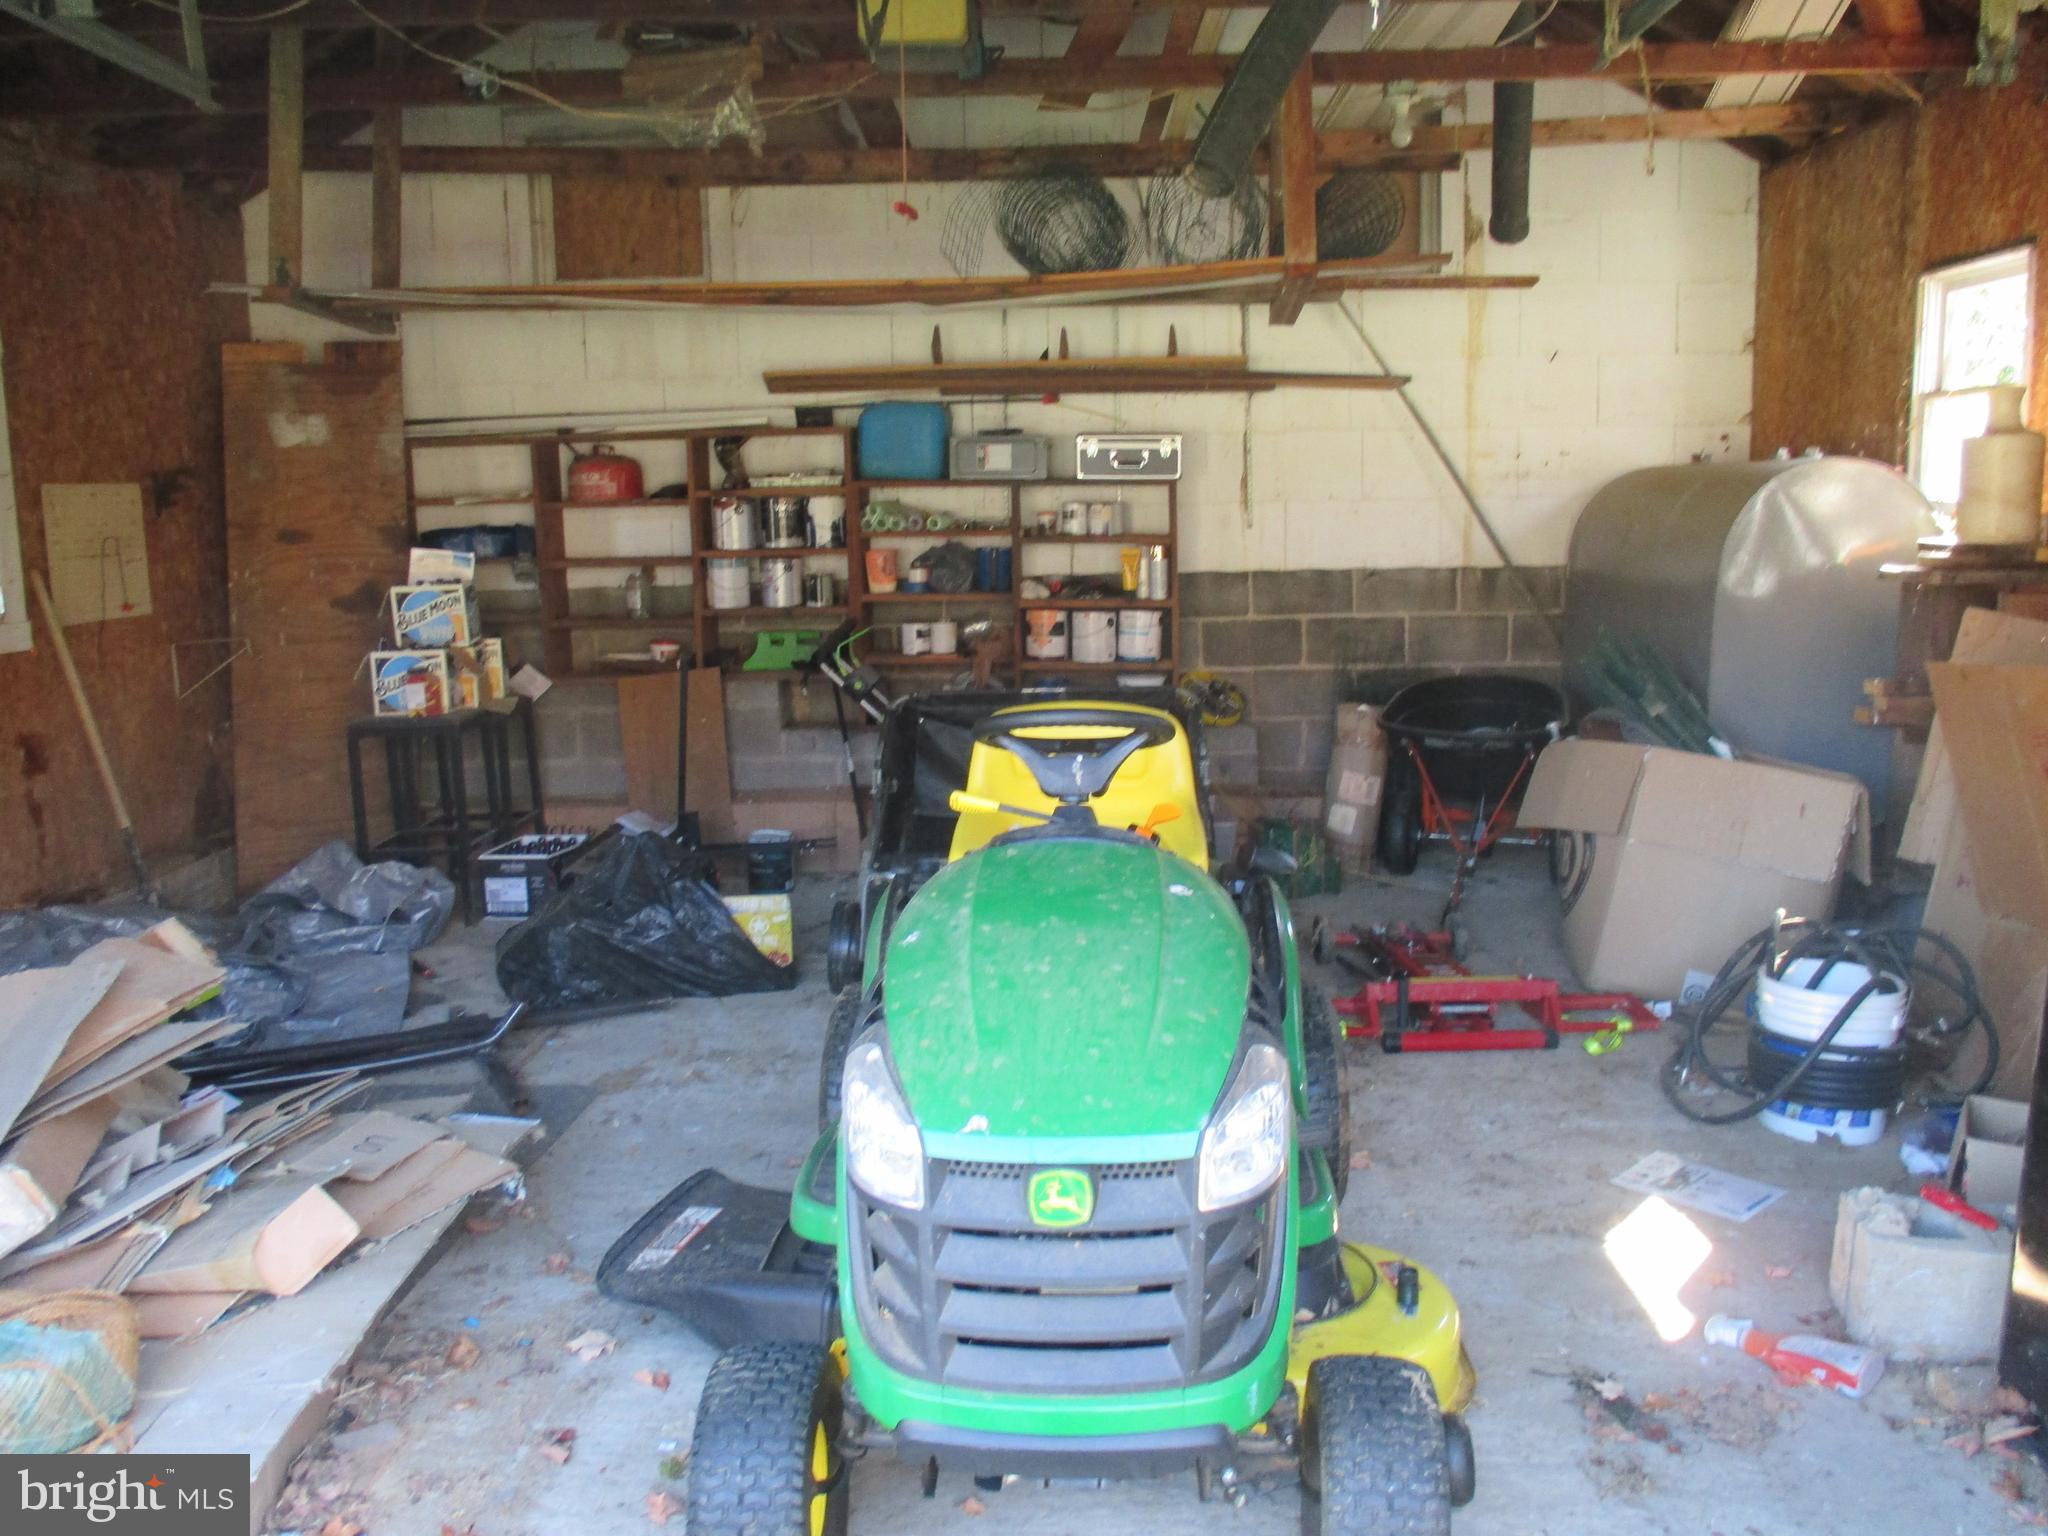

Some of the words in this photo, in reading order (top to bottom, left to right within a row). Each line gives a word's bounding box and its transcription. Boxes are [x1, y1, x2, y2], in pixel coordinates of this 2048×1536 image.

[397, 608, 428, 630] BLUE
[429, 594, 461, 617] MOON
[375, 674, 407, 697] BLUE
